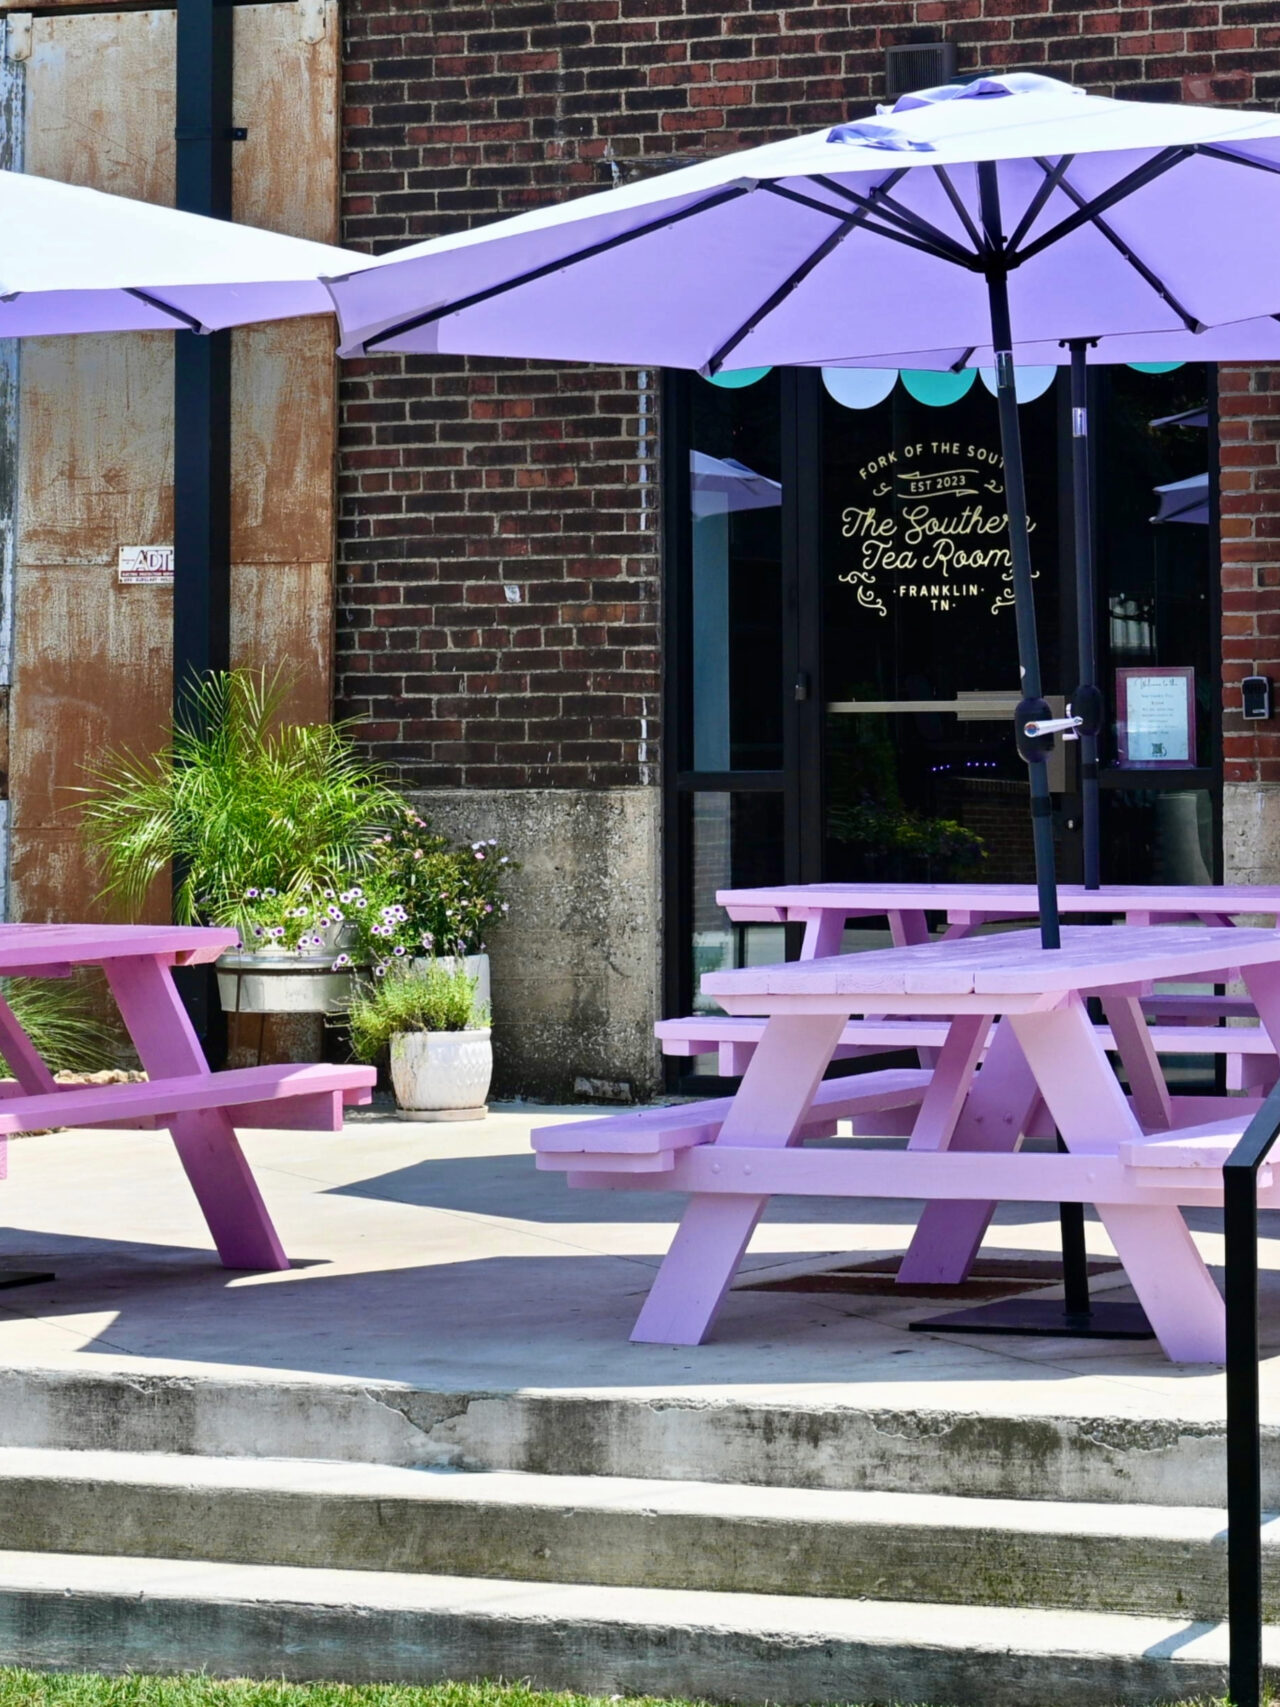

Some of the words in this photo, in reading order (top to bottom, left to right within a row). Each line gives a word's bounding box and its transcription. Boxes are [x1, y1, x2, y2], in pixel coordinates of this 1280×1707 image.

[859, 451, 898, 480] FORK
[904, 443, 923, 458] OF
[931, 442, 960, 455] THE
[910, 480, 932, 492] EST
[936, 475, 966, 489] 2023
[842, 507, 897, 537] The
[131, 550, 172, 571] ADT
[862, 539, 917, 570] Tea
[922, 538, 1013, 577] Room
[899, 584, 979, 597] FRANKLIN
[931, 600, 950, 611] TN
